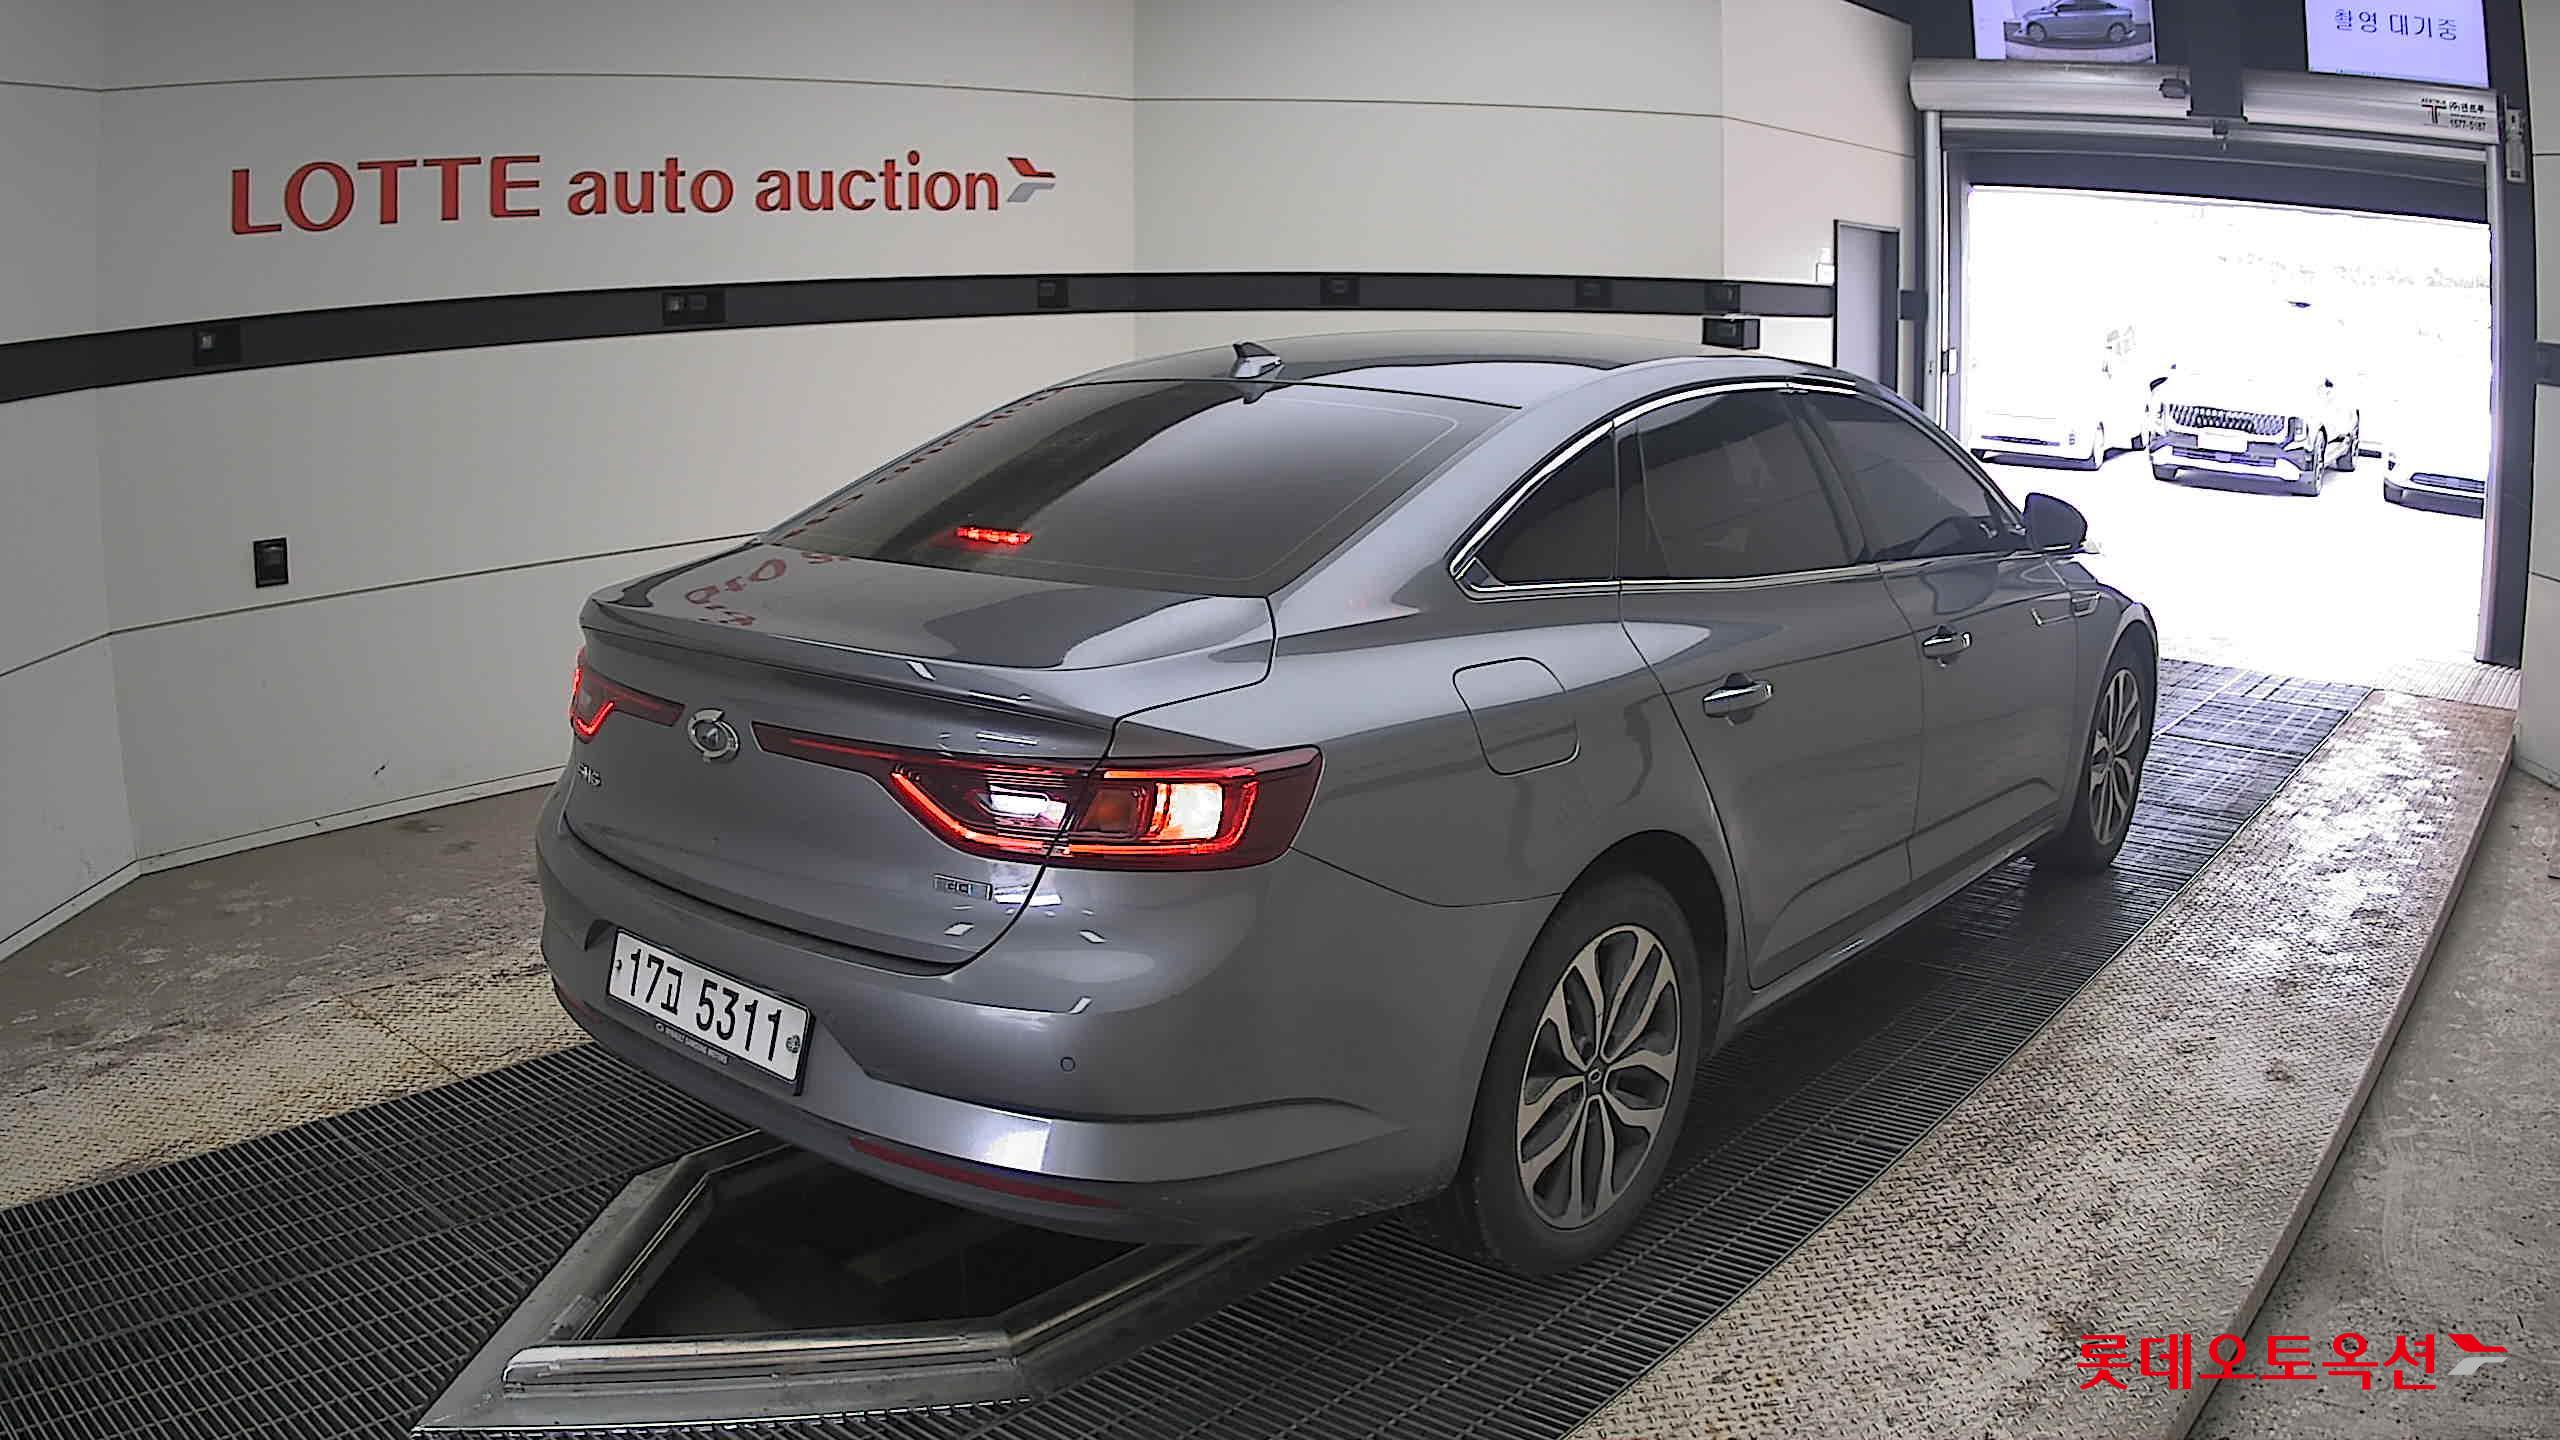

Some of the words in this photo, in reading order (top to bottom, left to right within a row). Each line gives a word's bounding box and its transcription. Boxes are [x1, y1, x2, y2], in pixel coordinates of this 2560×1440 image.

[2335, 8, 2377, 33] 촬영
[2389, 13, 2457, 41] 대기중
[231, 154, 541, 235] LOTTE
[567, 157, 735, 216] auto
[754, 149, 1000, 212] auction
[629, 947, 684, 1016] 17고
[695, 978, 783, 1062] 5311
